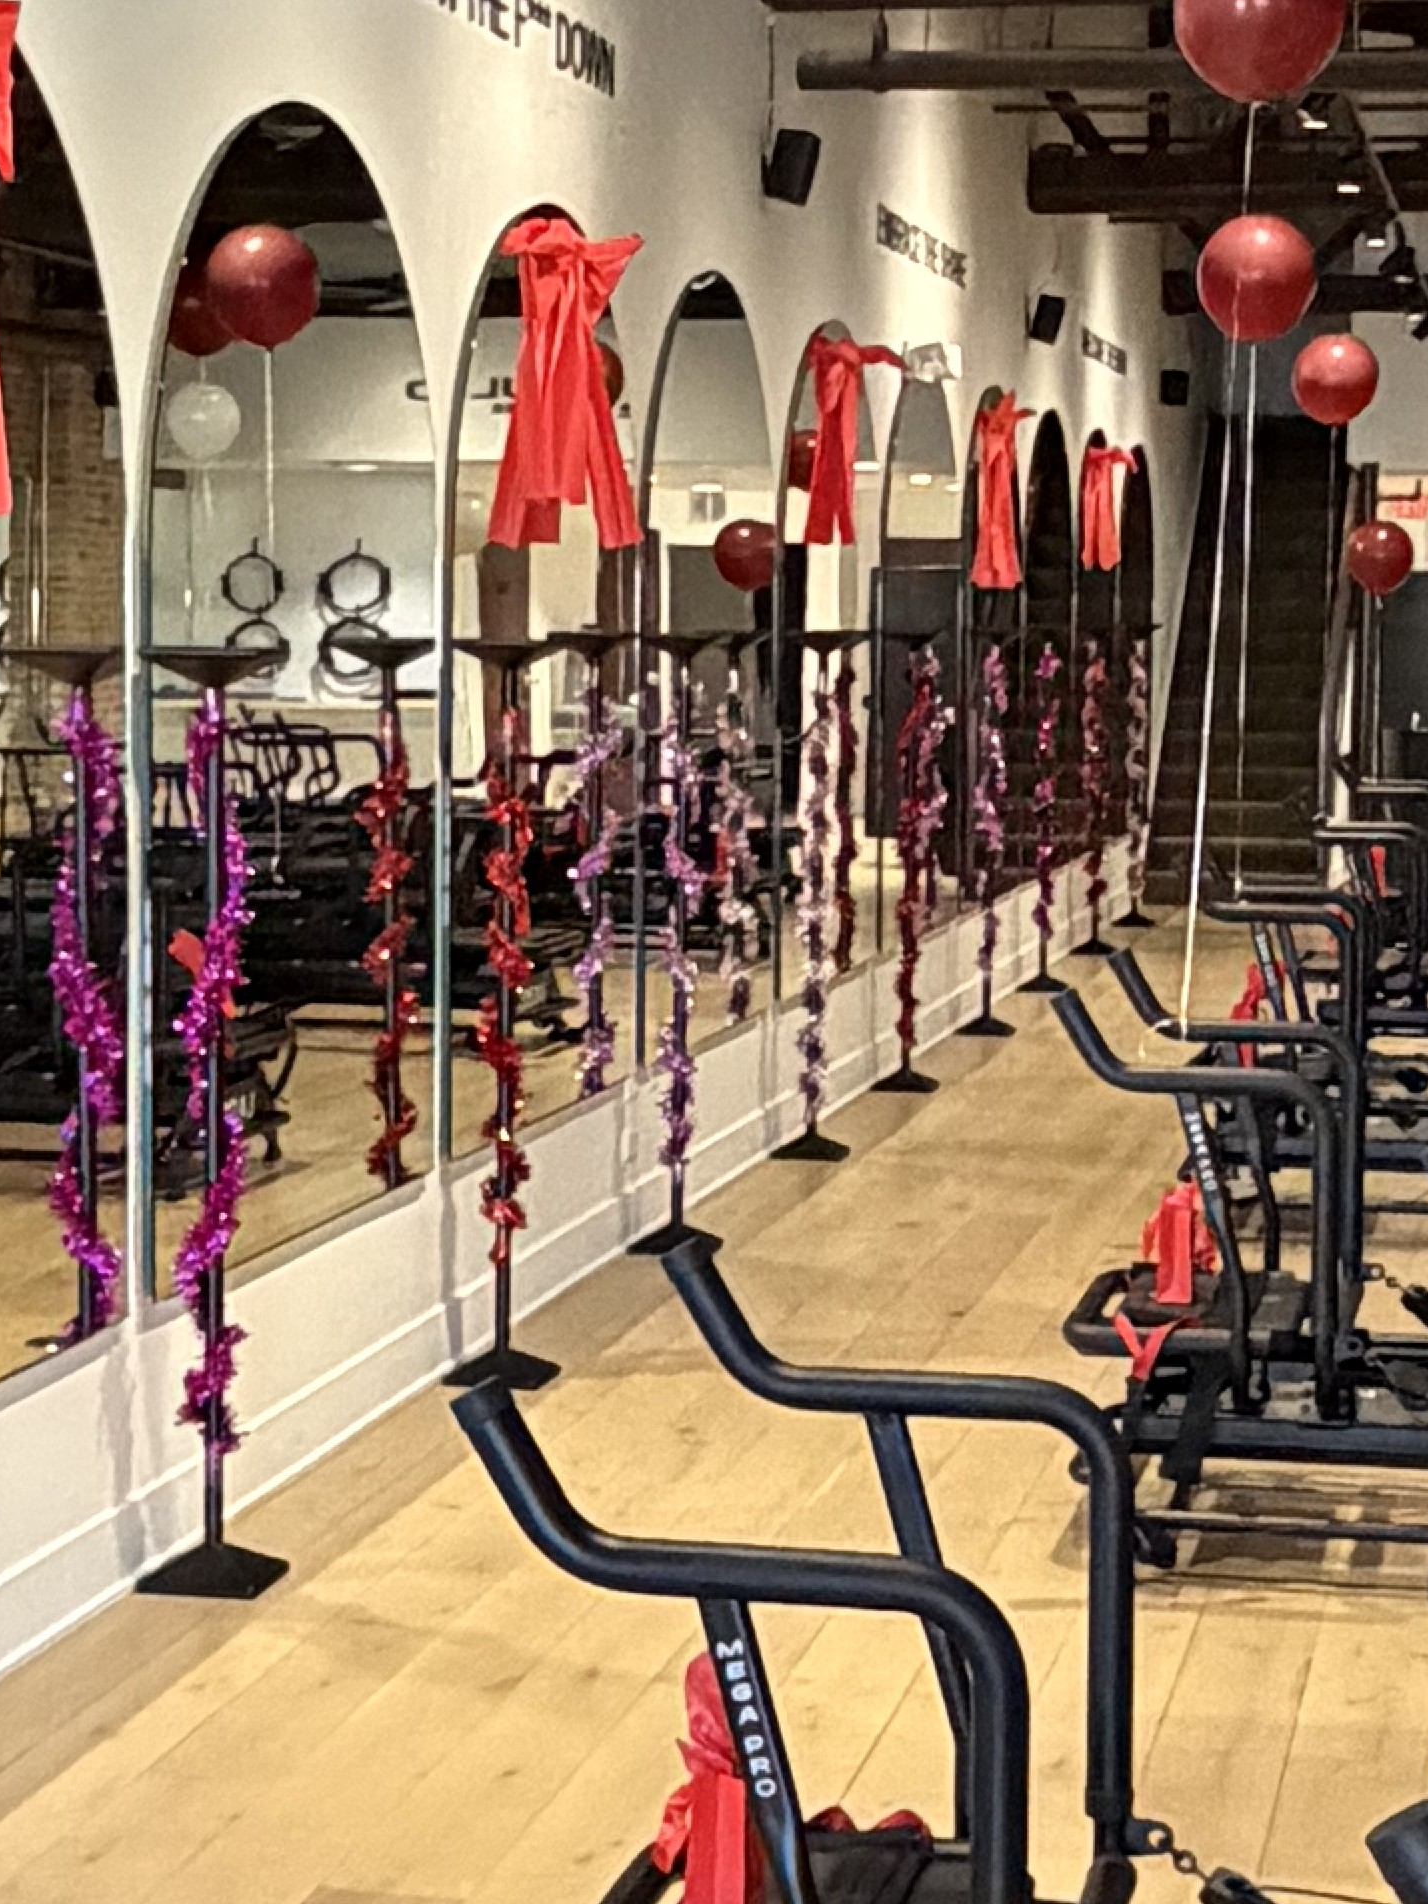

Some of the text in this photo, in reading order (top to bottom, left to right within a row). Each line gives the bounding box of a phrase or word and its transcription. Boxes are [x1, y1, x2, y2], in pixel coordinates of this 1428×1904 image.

[556, 10, 616, 99] DOWN
[715, 1638, 777, 1798] MEGA PRO
